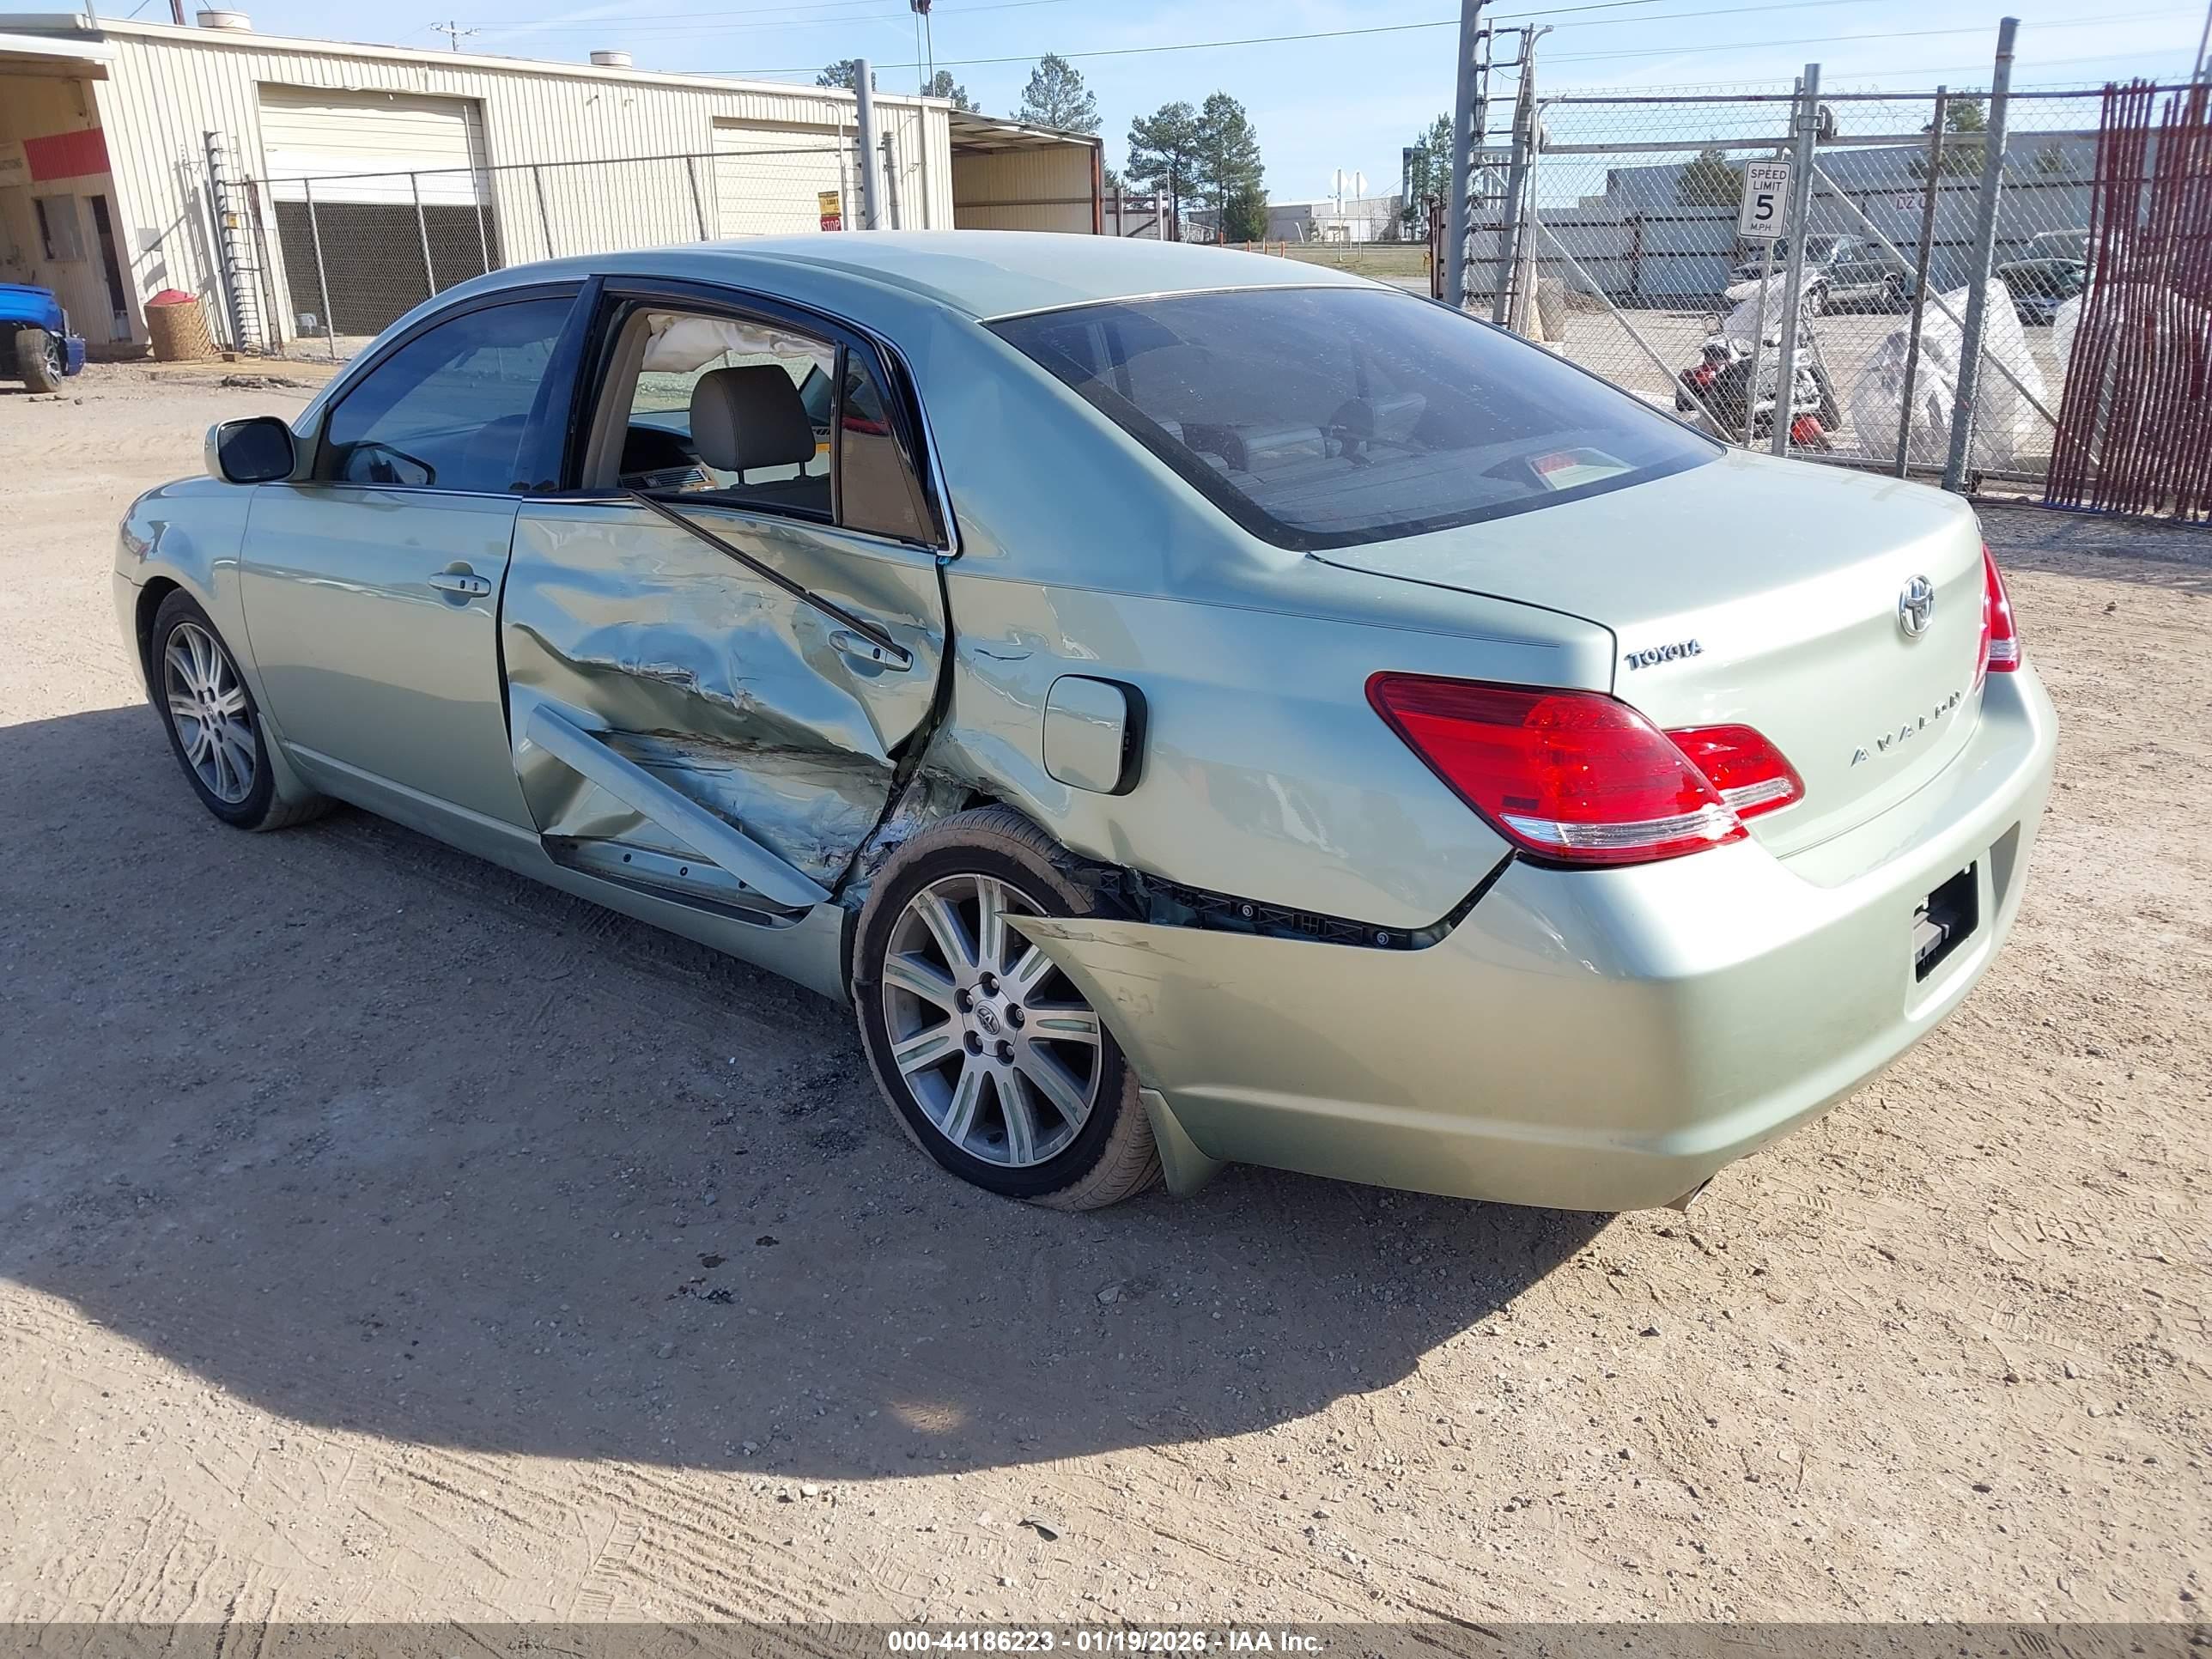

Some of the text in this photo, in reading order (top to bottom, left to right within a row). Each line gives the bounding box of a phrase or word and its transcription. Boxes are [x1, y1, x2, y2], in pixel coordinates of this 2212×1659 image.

[1750, 168, 1787, 180] SPEED
[1753, 180, 1783, 191] LIMIT
[1754, 194, 1774, 221] 5
[822, 219, 841, 232] STOP
[1624, 638, 1705, 671] TOYOTA
[1850, 690, 1961, 768] AVALON
